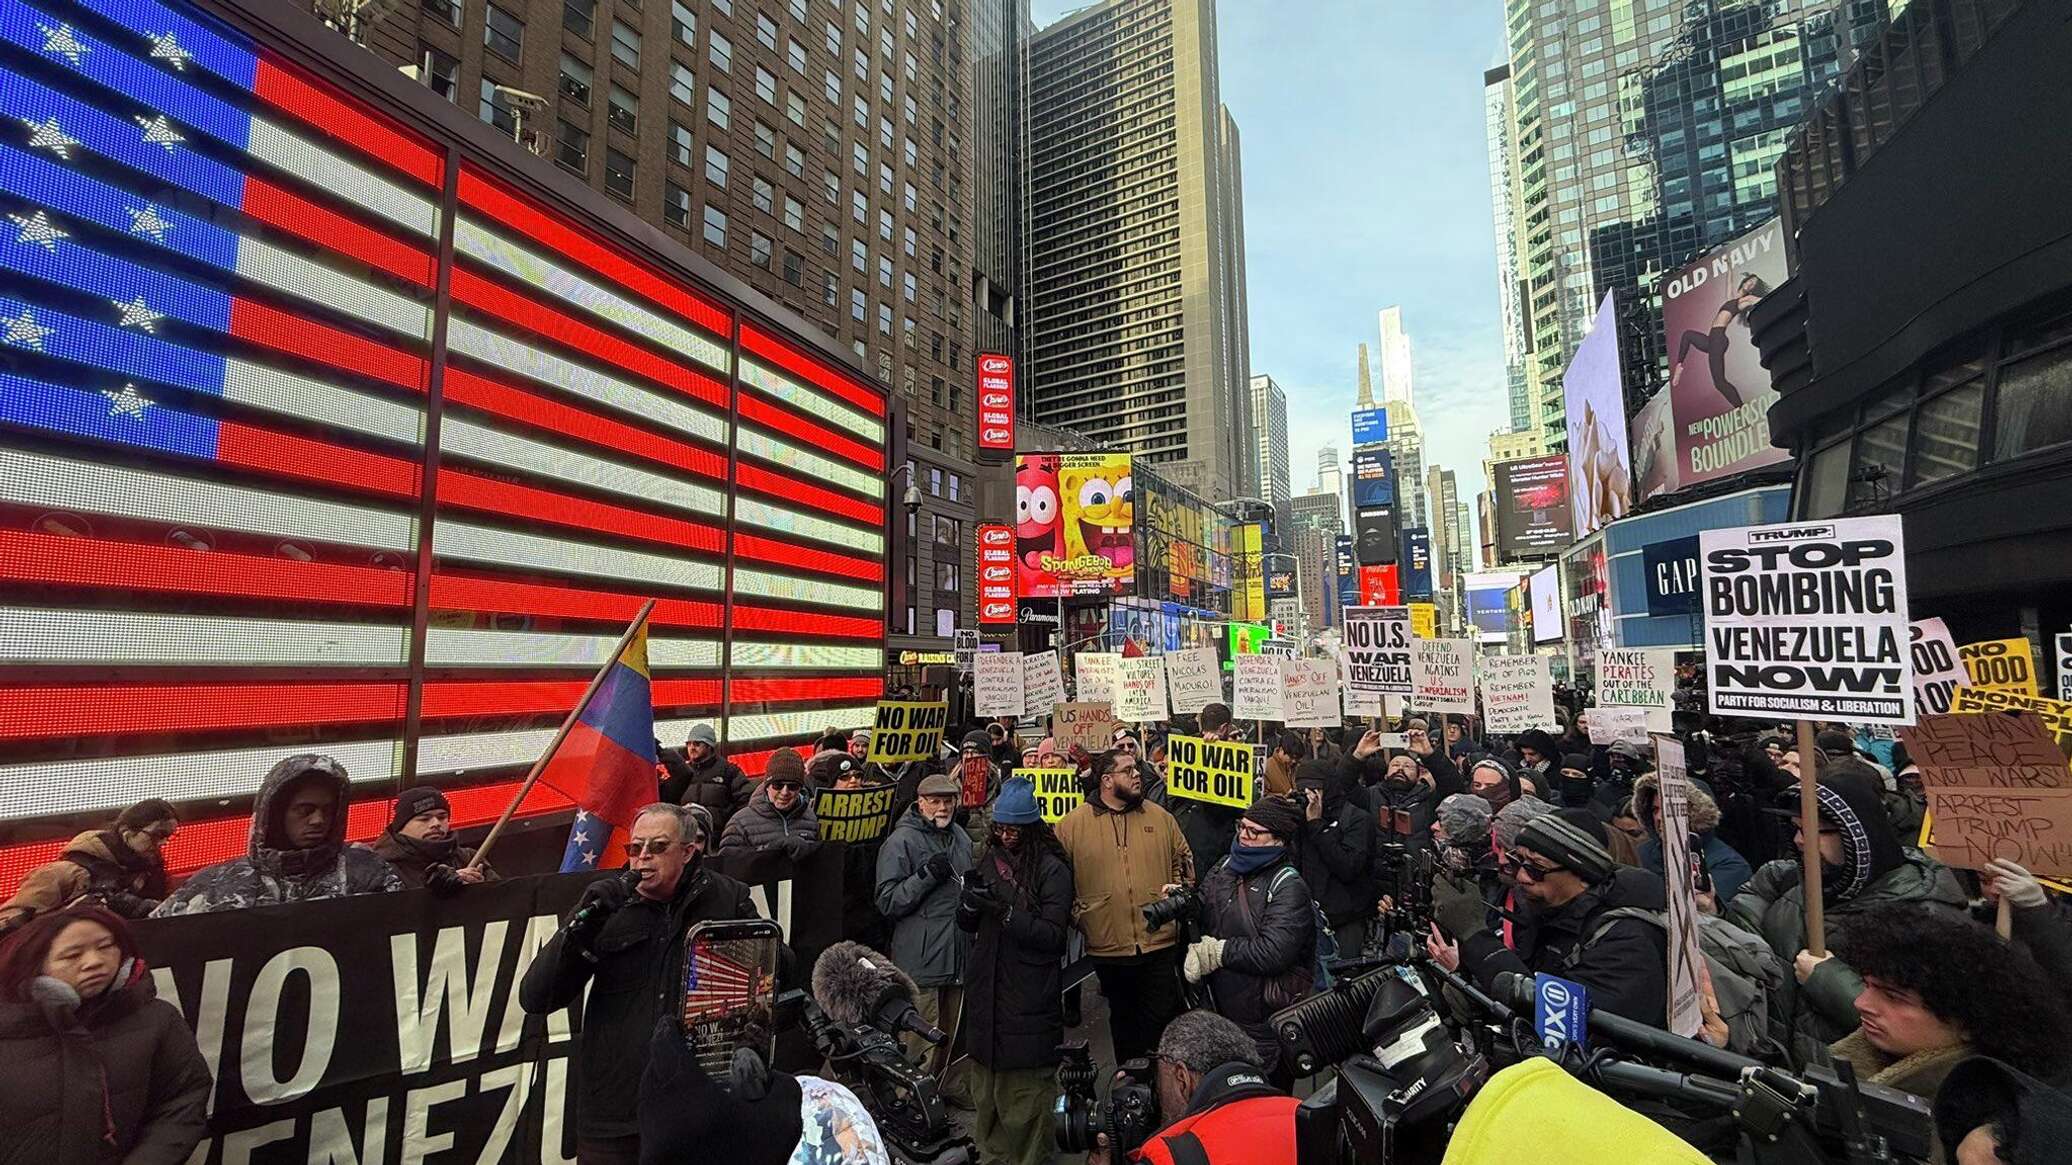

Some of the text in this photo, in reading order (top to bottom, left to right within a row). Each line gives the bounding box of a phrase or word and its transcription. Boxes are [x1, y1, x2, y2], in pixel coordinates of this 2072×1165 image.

[1667, 229, 1776, 299] OLD NAVY
[1688, 420, 1703, 436] NEW
[1751, 527, 1832, 541] TRUMP:
[1707, 539, 1894, 574] STOP
[1656, 557, 1698, 596] GAP
[1709, 568, 1896, 617] BOMBING
[1346, 621, 1410, 649] NO U.S.
[956, 637, 978, 649] BLOOD
[1422, 641, 1452, 652] DEFEND
[1712, 625, 1901, 664] VENEZUELA
[1958, 641, 2008, 660] NO
[1083, 656, 1112, 665] YANKEE
[1118, 658, 1160, 670] WALL STREET
[1176, 651, 1200, 663] FREE
[1348, 651, 1412, 666] WAR
[1417, 652, 1461, 665] VENEZUELA
[1488, 656, 1538, 668] REMEMBER
[1601, 650, 1646, 666] YANKEE
[1125, 669, 1156, 680] VULTURES
[1172, 663, 1207, 677] NICOLAS
[1238, 666, 1278, 675] VENEZUELA
[1349, 665, 1412, 684] VENEZUELA
[1424, 664, 1460, 677] AGAINST
[1482, 667, 1537, 681] BAY OF PIGS
[1602, 665, 1655, 680] PIRATES
[1123, 679, 1155, 689] HANDS OFF
[1239, 677, 1265, 685] CONTRA
[1284, 671, 1328, 685] HANDS OFF
[1602, 679, 1653, 690] OUT OF THE
[1715, 664, 1902, 694] NOW!
[1103, 686, 1111, 695] OF
[1417, 685, 1468, 697] IMPERIALISM
[1489, 681, 1536, 691] REMEMBER
[1125, 696, 1151, 705] AMERICA
[1488, 692, 1529, 703] VIETNAM!
[1601, 688, 1665, 705] CARIBBEAN
[1960, 687, 2072, 714] MONEY
[1488, 705, 1529, 715] DEMOCRATIC
[1717, 694, 1747, 707] PARTY
[1748, 696, 1767, 708] FOR
[1767, 697, 1820, 712] SOCIALISM
[1820, 699, 1835, 712] &
[1836, 699, 1901, 715] LIBERATION
[876, 706, 946, 730] NO WAR
[1060, 709, 1077, 723] US
[1079, 709, 1112, 721] HANDS
[1490, 715, 1510, 724] PARTY
[1072, 722, 1094, 736] OFF
[1906, 715, 1967, 741] WE
[874, 731, 939, 756] FOR OIL
[1171, 740, 1250, 774] NO WAR
[1918, 740, 2062, 767] PEACE
[1040, 773, 1083, 794] WAR
[1173, 766, 1246, 801] FOR OIL
[1925, 767, 1967, 787] NOT
[815, 787, 896, 817] ARREST
[1935, 794, 2042, 817] ARREST
[816, 814, 888, 843] TRUMP
[1941, 816, 2053, 840] TRUMP
[151, 945, 341, 1118] NO
